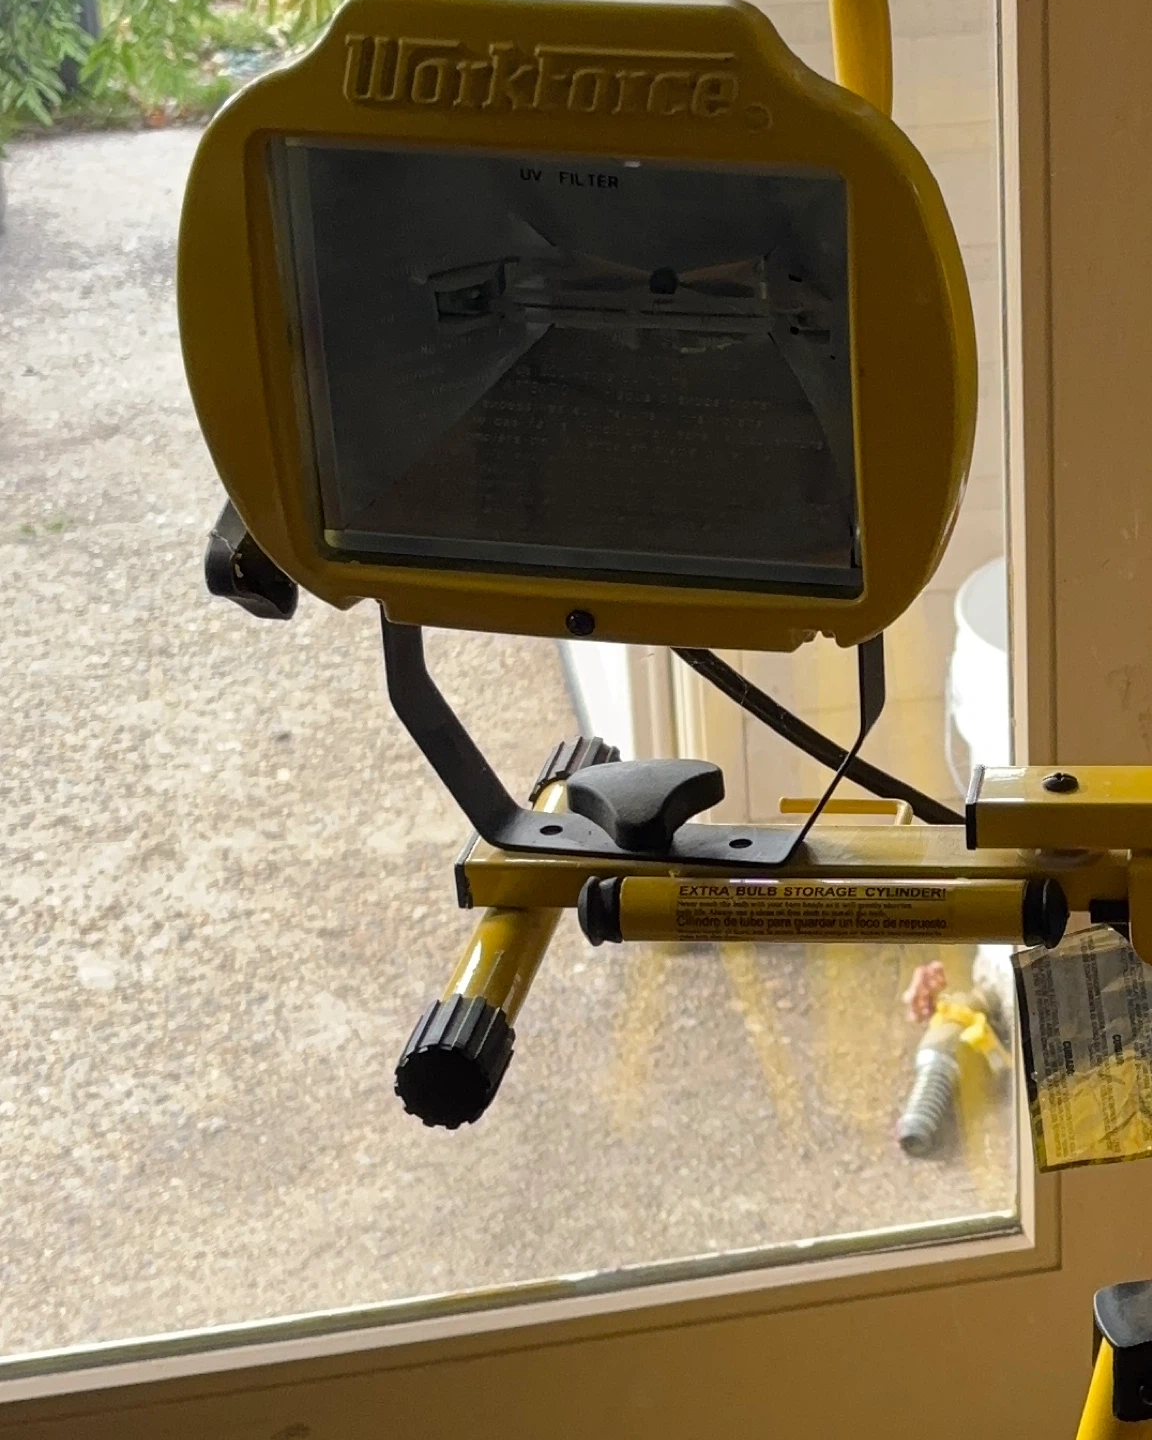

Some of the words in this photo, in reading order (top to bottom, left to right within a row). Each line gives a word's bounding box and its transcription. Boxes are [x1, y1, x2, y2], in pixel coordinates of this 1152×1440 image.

[344, 34, 739, 117] WorkForce
[520, 168, 542, 182] UV
[559, 171, 620, 189] FILTER
[679, 885, 730, 897] EXTRA
[735, 885, 778, 897] BULB
[783, 886, 858, 898] STORAGE
[865, 887, 947, 899] CYLINDER!
[676, 915, 720, 927] Cilindro
[724, 915, 738, 927] de
[740, 915, 764, 927] tubo
[768, 919, 792, 931] para
[794, 917, 836, 932] guardar
[838, 919, 854, 929] un
[856, 916, 880, 929] foco
[883, 917, 897, 929] de
